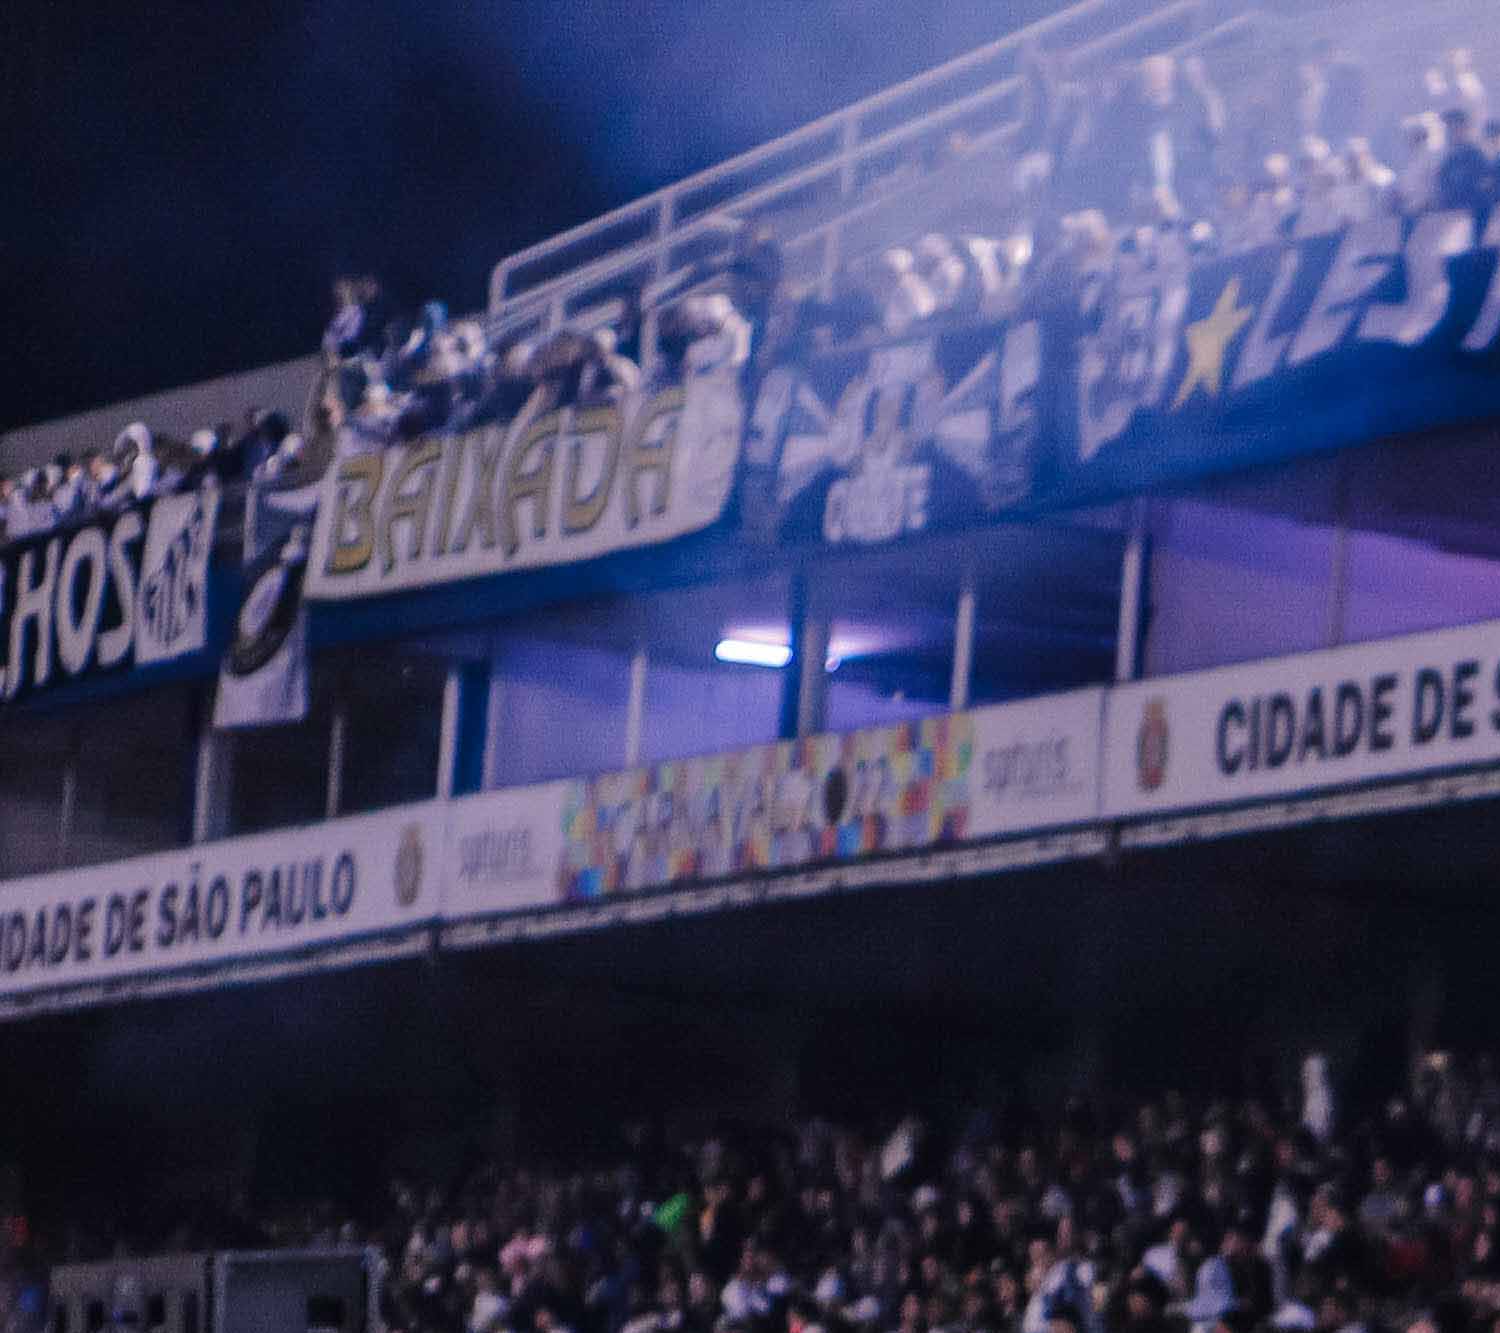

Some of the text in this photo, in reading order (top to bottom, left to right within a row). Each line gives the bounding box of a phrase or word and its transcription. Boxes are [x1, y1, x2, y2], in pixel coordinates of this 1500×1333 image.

[323, 385, 688, 578] BAIXADA
[0, 508, 143, 702] HOS
[1216, 672, 1399, 776] CIDADE
[1410, 659, 1482, 746] DE
[104, 887, 150, 959] DE
[156, 861, 231, 948] SÃO
[240, 849, 355, 935] PAULO
